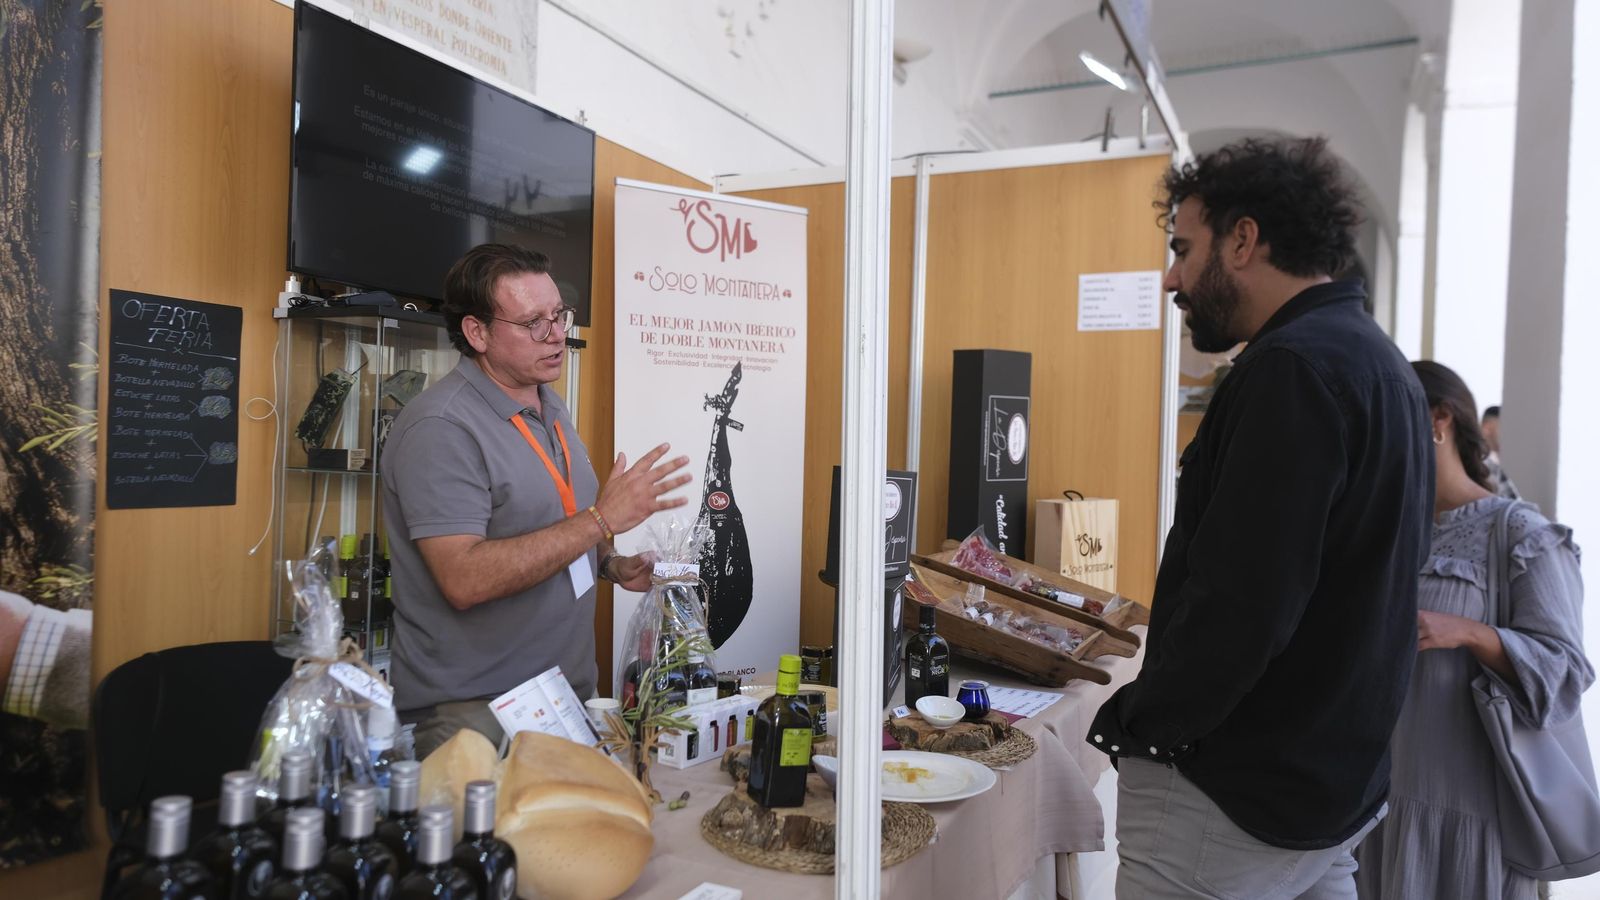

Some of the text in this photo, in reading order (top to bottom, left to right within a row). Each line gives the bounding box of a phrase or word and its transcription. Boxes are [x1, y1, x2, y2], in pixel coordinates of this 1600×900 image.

[393, 6, 446, 46] VESPERAL
[439, 3, 469, 32] DONDE
[475, 18, 512, 54] ORIENTE
[121, 299, 210, 331] OFERTA
[629, 313, 648, 327] EL
[651, 315, 695, 331] MEJOR
[148, 327, 213, 350] FERIA
[640, 331, 785, 354] DE DOBLE MONTANERA
[114, 353, 199, 374] BOTE MERMELADA
[646, 349, 665, 359] Rigor
[668, 350, 708, 360] Exclusividad
[653, 357, 700, 368] Sostenibilidad
[114, 373, 151, 386] BOTELLA
[112, 406, 143, 418] BOTE
[112, 424, 142, 437] BOTE
